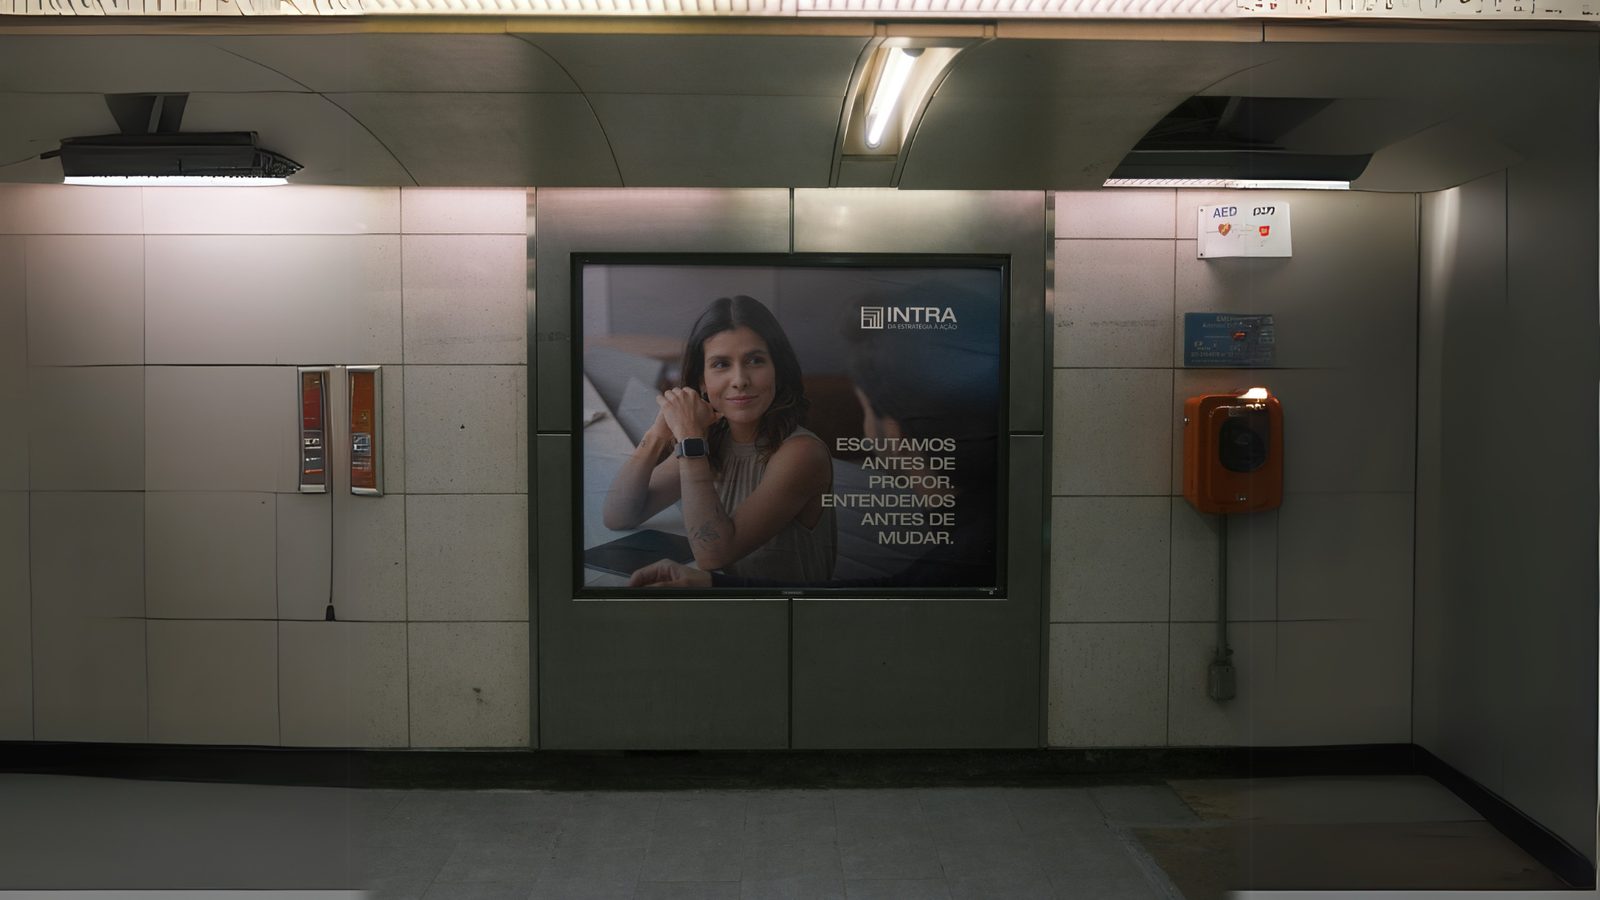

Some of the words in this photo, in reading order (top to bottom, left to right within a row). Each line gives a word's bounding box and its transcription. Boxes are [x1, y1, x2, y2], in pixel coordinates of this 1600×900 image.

[1213, 206, 1238, 218] AED
[887, 306, 957, 322] INTRA
[836, 437, 956, 452] ESCUTAMOS
[861, 456, 925, 470] ANTES
[930, 456, 956, 470] DE
[869, 475, 955, 489] PROPOR.
[821, 493, 956, 508] ENTENDEMOS
[861, 512, 924, 526] ANTES
[929, 512, 955, 526] DE
[878, 531, 954, 545] MUDAR.
